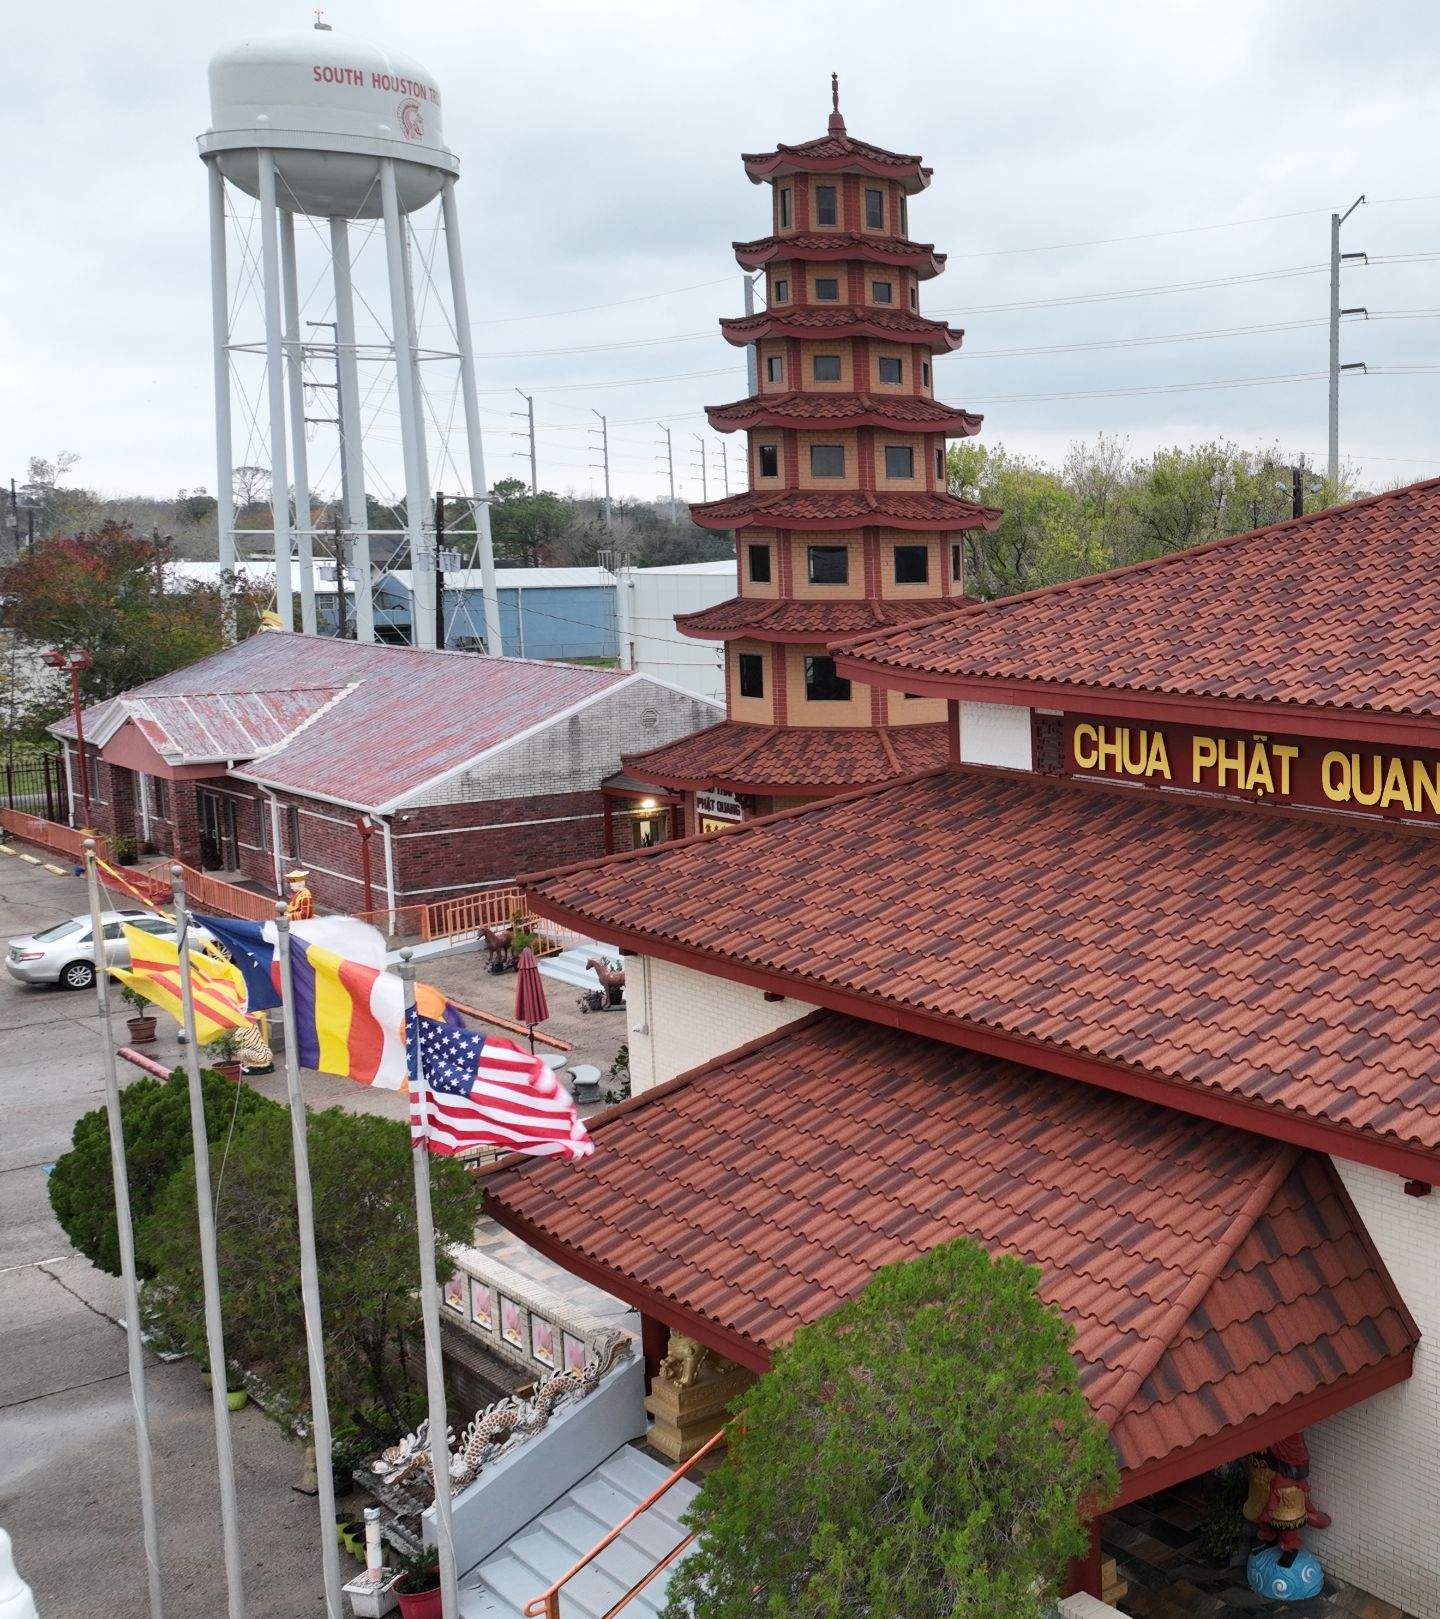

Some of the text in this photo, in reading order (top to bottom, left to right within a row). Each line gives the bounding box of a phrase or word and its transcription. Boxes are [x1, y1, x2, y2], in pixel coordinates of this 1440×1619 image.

[313, 65, 364, 87] SOUTH
[371, 72, 427, 100] HOUSTON
[1072, 723, 1172, 780] CHUA
[1192, 734, 1299, 797] PHẬT
